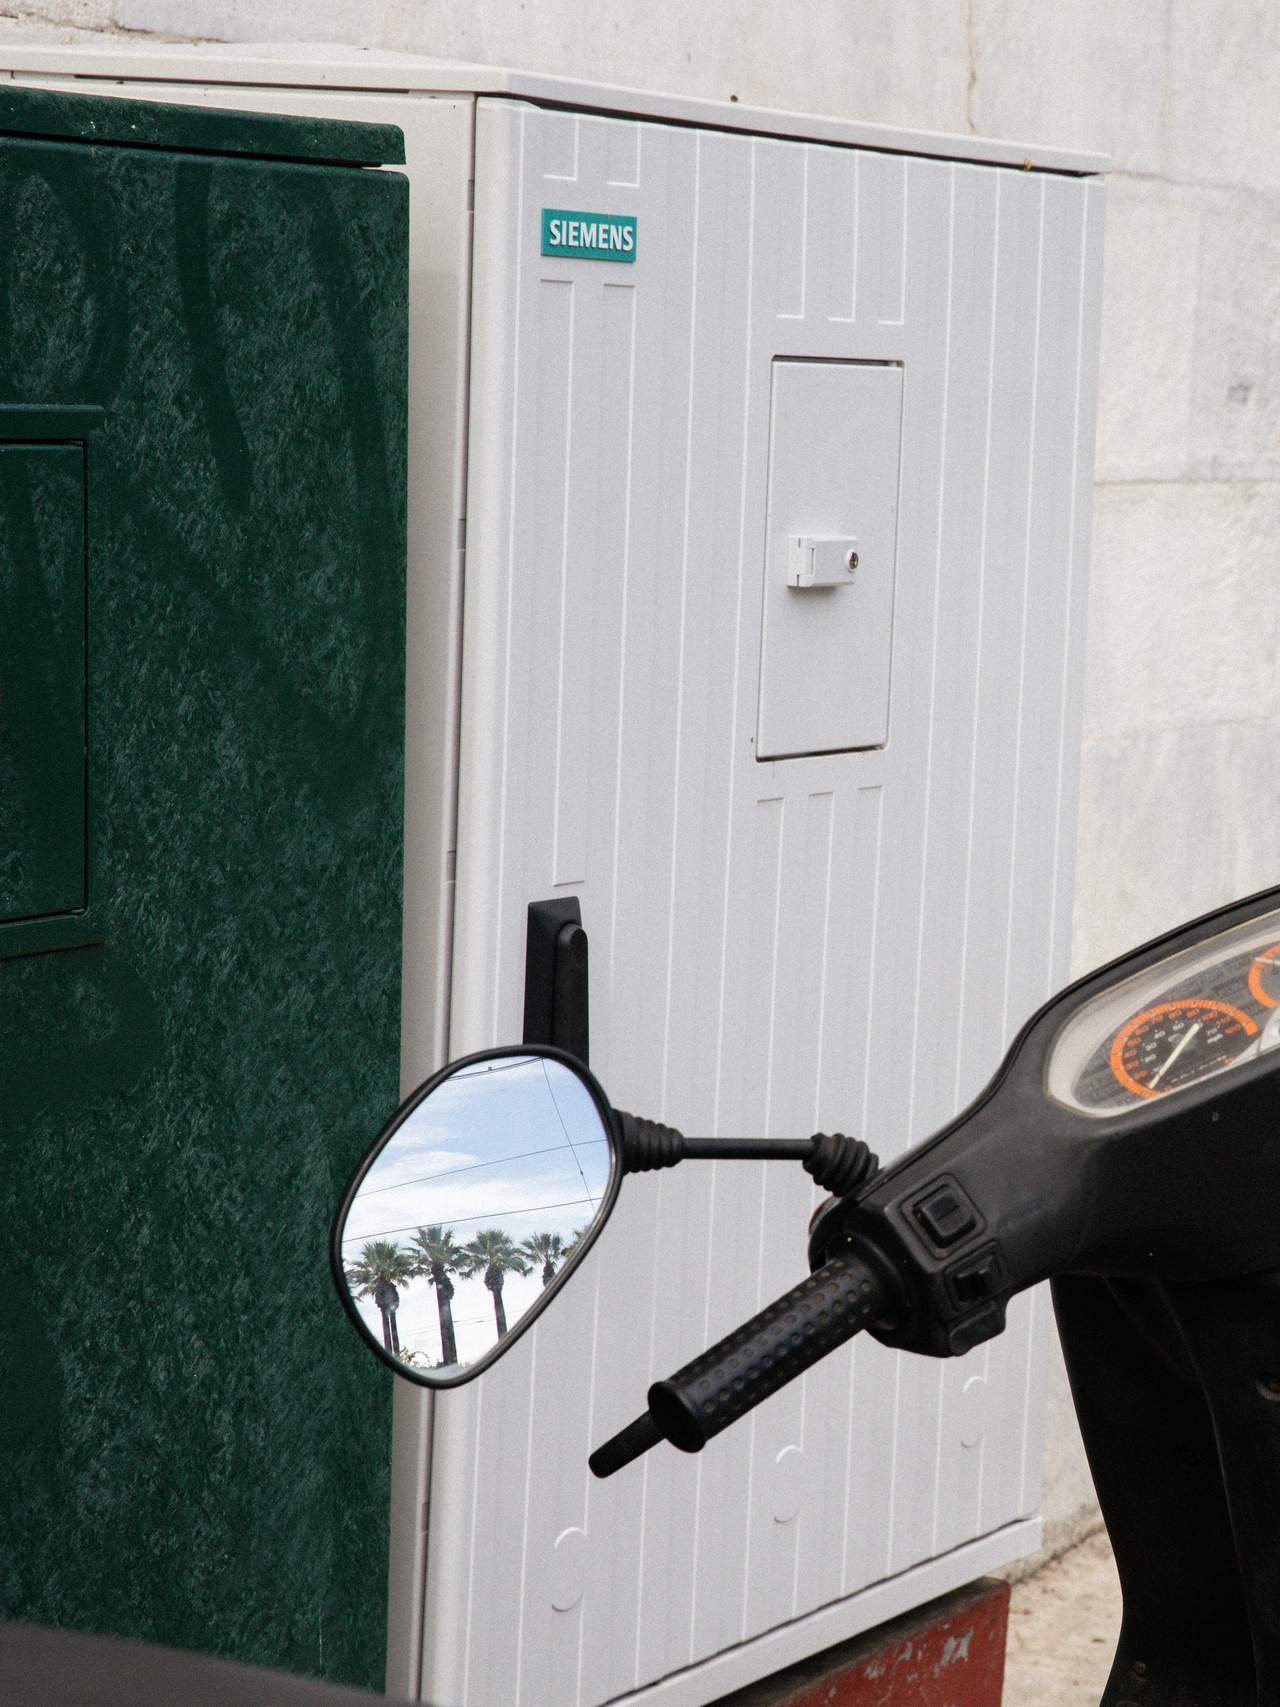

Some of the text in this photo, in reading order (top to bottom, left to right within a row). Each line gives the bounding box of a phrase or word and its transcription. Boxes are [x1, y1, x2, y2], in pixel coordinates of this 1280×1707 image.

[550, 219, 633, 251] SIEMENS
[1168, 1010, 1182, 1020] 80
[1201, 1011, 1218, 1021] 100
[1154, 1031, 1165, 1039] 40
[1123, 1049, 1137, 1058] 40
[1126, 1060, 1138, 1070] 30
[1133, 1070, 1147, 1080] 20
